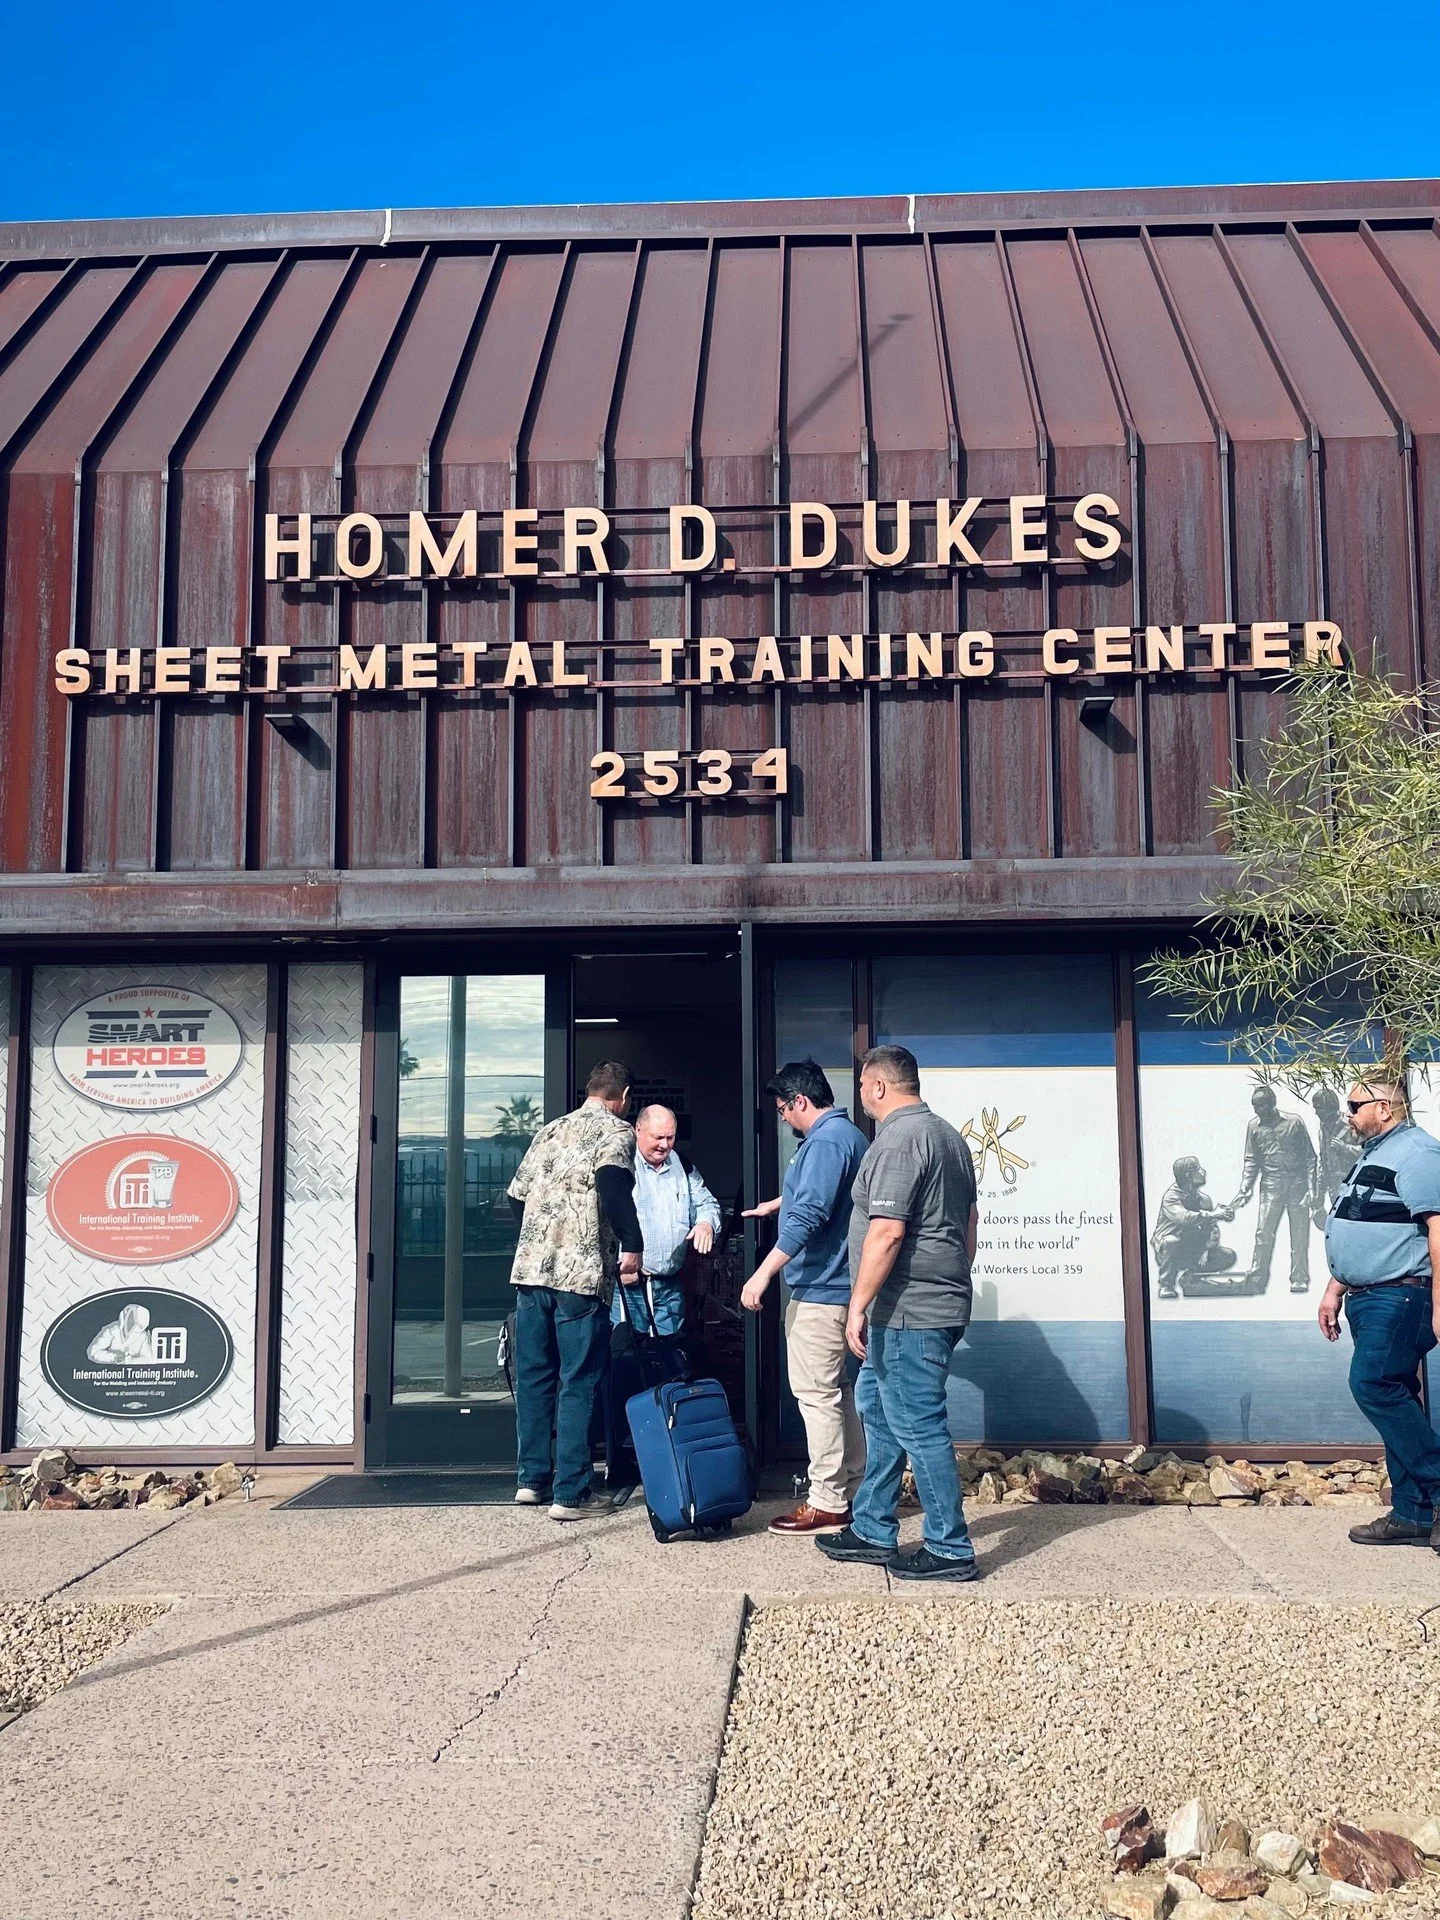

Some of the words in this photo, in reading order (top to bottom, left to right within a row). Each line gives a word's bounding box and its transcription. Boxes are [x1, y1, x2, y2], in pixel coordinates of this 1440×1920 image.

[265, 507, 610, 580] HOMER
[669, 505, 735, 573] D.
[790, 493, 1121, 570] DUKES
[54, 645, 291, 694] SHEET
[340, 640, 589, 690] METAL
[649, 630, 994, 684] TRAINING
[1042, 620, 1344, 675] CENTER
[590, 747, 788, 798] 2534
[115, 991, 138, 1001] PROUD
[140, 990, 179, 998] SUPPORTER
[181, 993, 191, 1002] OF
[88, 1023, 204, 1043] SMART
[87, 1048, 205, 1066] HEROES
[68, 1073, 86, 1088] FROM
[86, 1085, 115, 1102] SERVING
[116, 1097, 147, 1106] AMERICA
[160, 1090, 194, 1105] BUILDING
[196, 1073, 224, 1094] AMERICA
[79, 1213, 130, 1224] International
[132, 1213, 165, 1225] Training
[983, 1210, 1019, 1225] doors
[1023, 1215, 1051, 1229] pass
[1055, 1209, 1075, 1225] the
[1076, 1209, 1114, 1229] finest
[997, 1237, 1010, 1250] in
[1014, 1235, 1035, 1250] the
[983, 1264, 1028, 1275] Workers
[1032, 1263, 1060, 1275] Local
[1063, 1264, 1083, 1275] 359
[73, 1368, 125, 1379] International
[127, 1368, 160, 1381] Training
